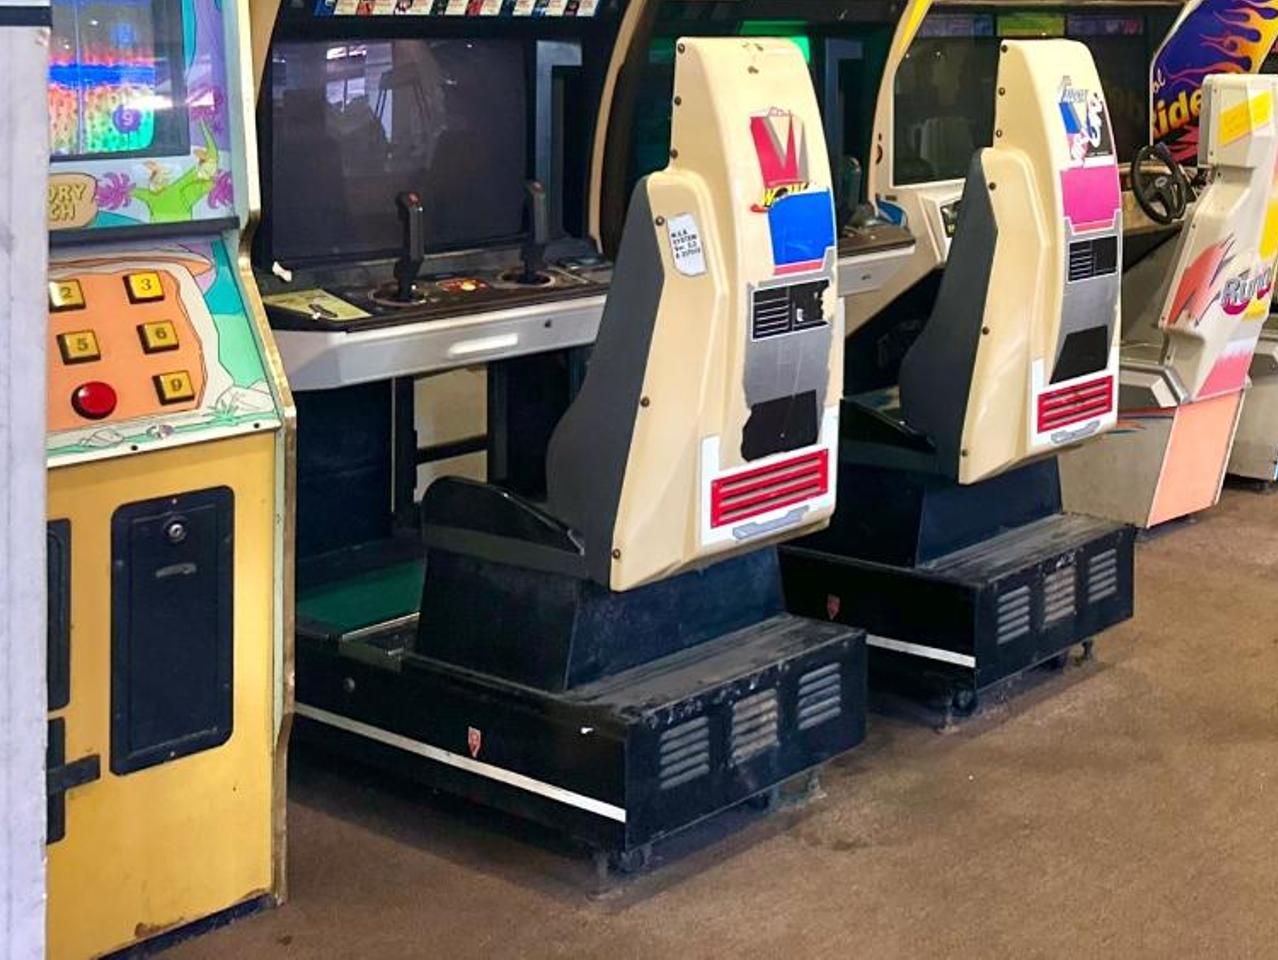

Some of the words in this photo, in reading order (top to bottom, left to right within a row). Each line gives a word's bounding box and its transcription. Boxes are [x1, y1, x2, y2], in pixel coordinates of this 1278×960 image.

[140, 278, 152, 292] 3
[61, 287, 72, 299] 2
[155, 327, 167, 340] 6
[77, 337, 89, 352] 5
[171, 378, 183, 392] 9
